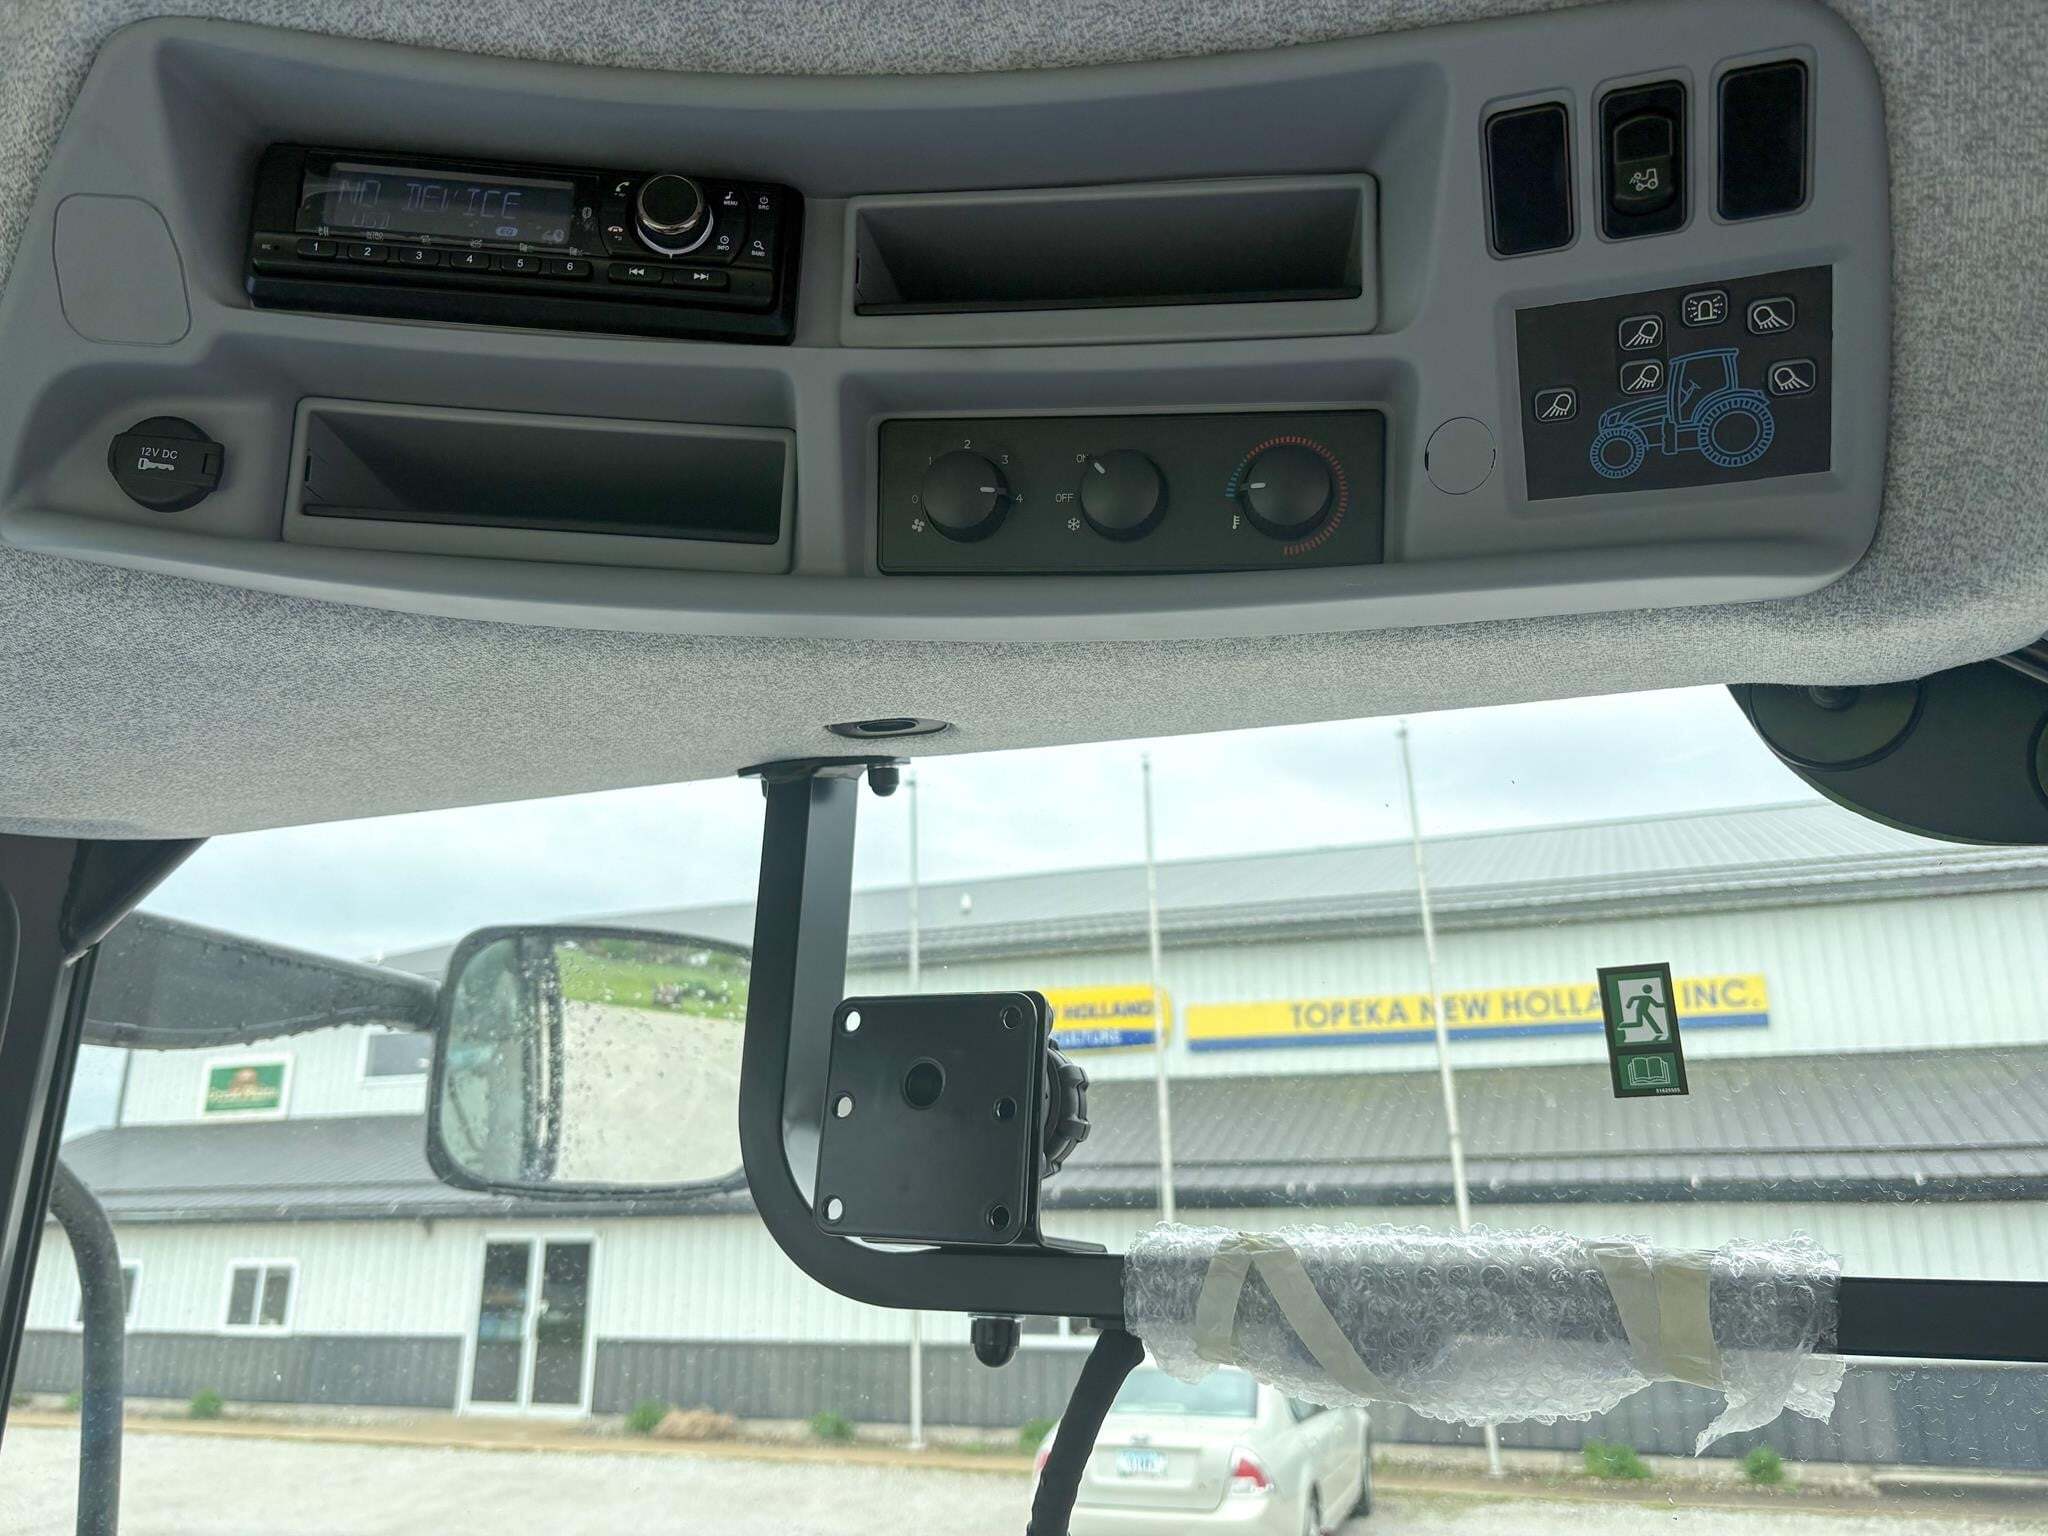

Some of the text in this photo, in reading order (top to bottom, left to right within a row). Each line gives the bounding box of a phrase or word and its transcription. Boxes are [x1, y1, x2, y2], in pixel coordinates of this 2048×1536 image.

[724, 198, 738, 207] MENU
[313, 242, 320, 252] 1
[364, 246, 372, 257] 2
[415, 250, 424, 262] 3
[465, 254, 474, 266] 4
[516, 258, 525, 269] 5
[566, 261, 575, 273] 6
[963, 439, 973, 450] 2
[140, 447, 178, 459] 12V DC
[1001, 454, 1010, 466] 3
[1015, 493, 1025, 504] 4
[1055, 493, 1074, 504] OFF
[1291, 979, 1761, 1028] TOPEKA NEW HOLLA INC.
